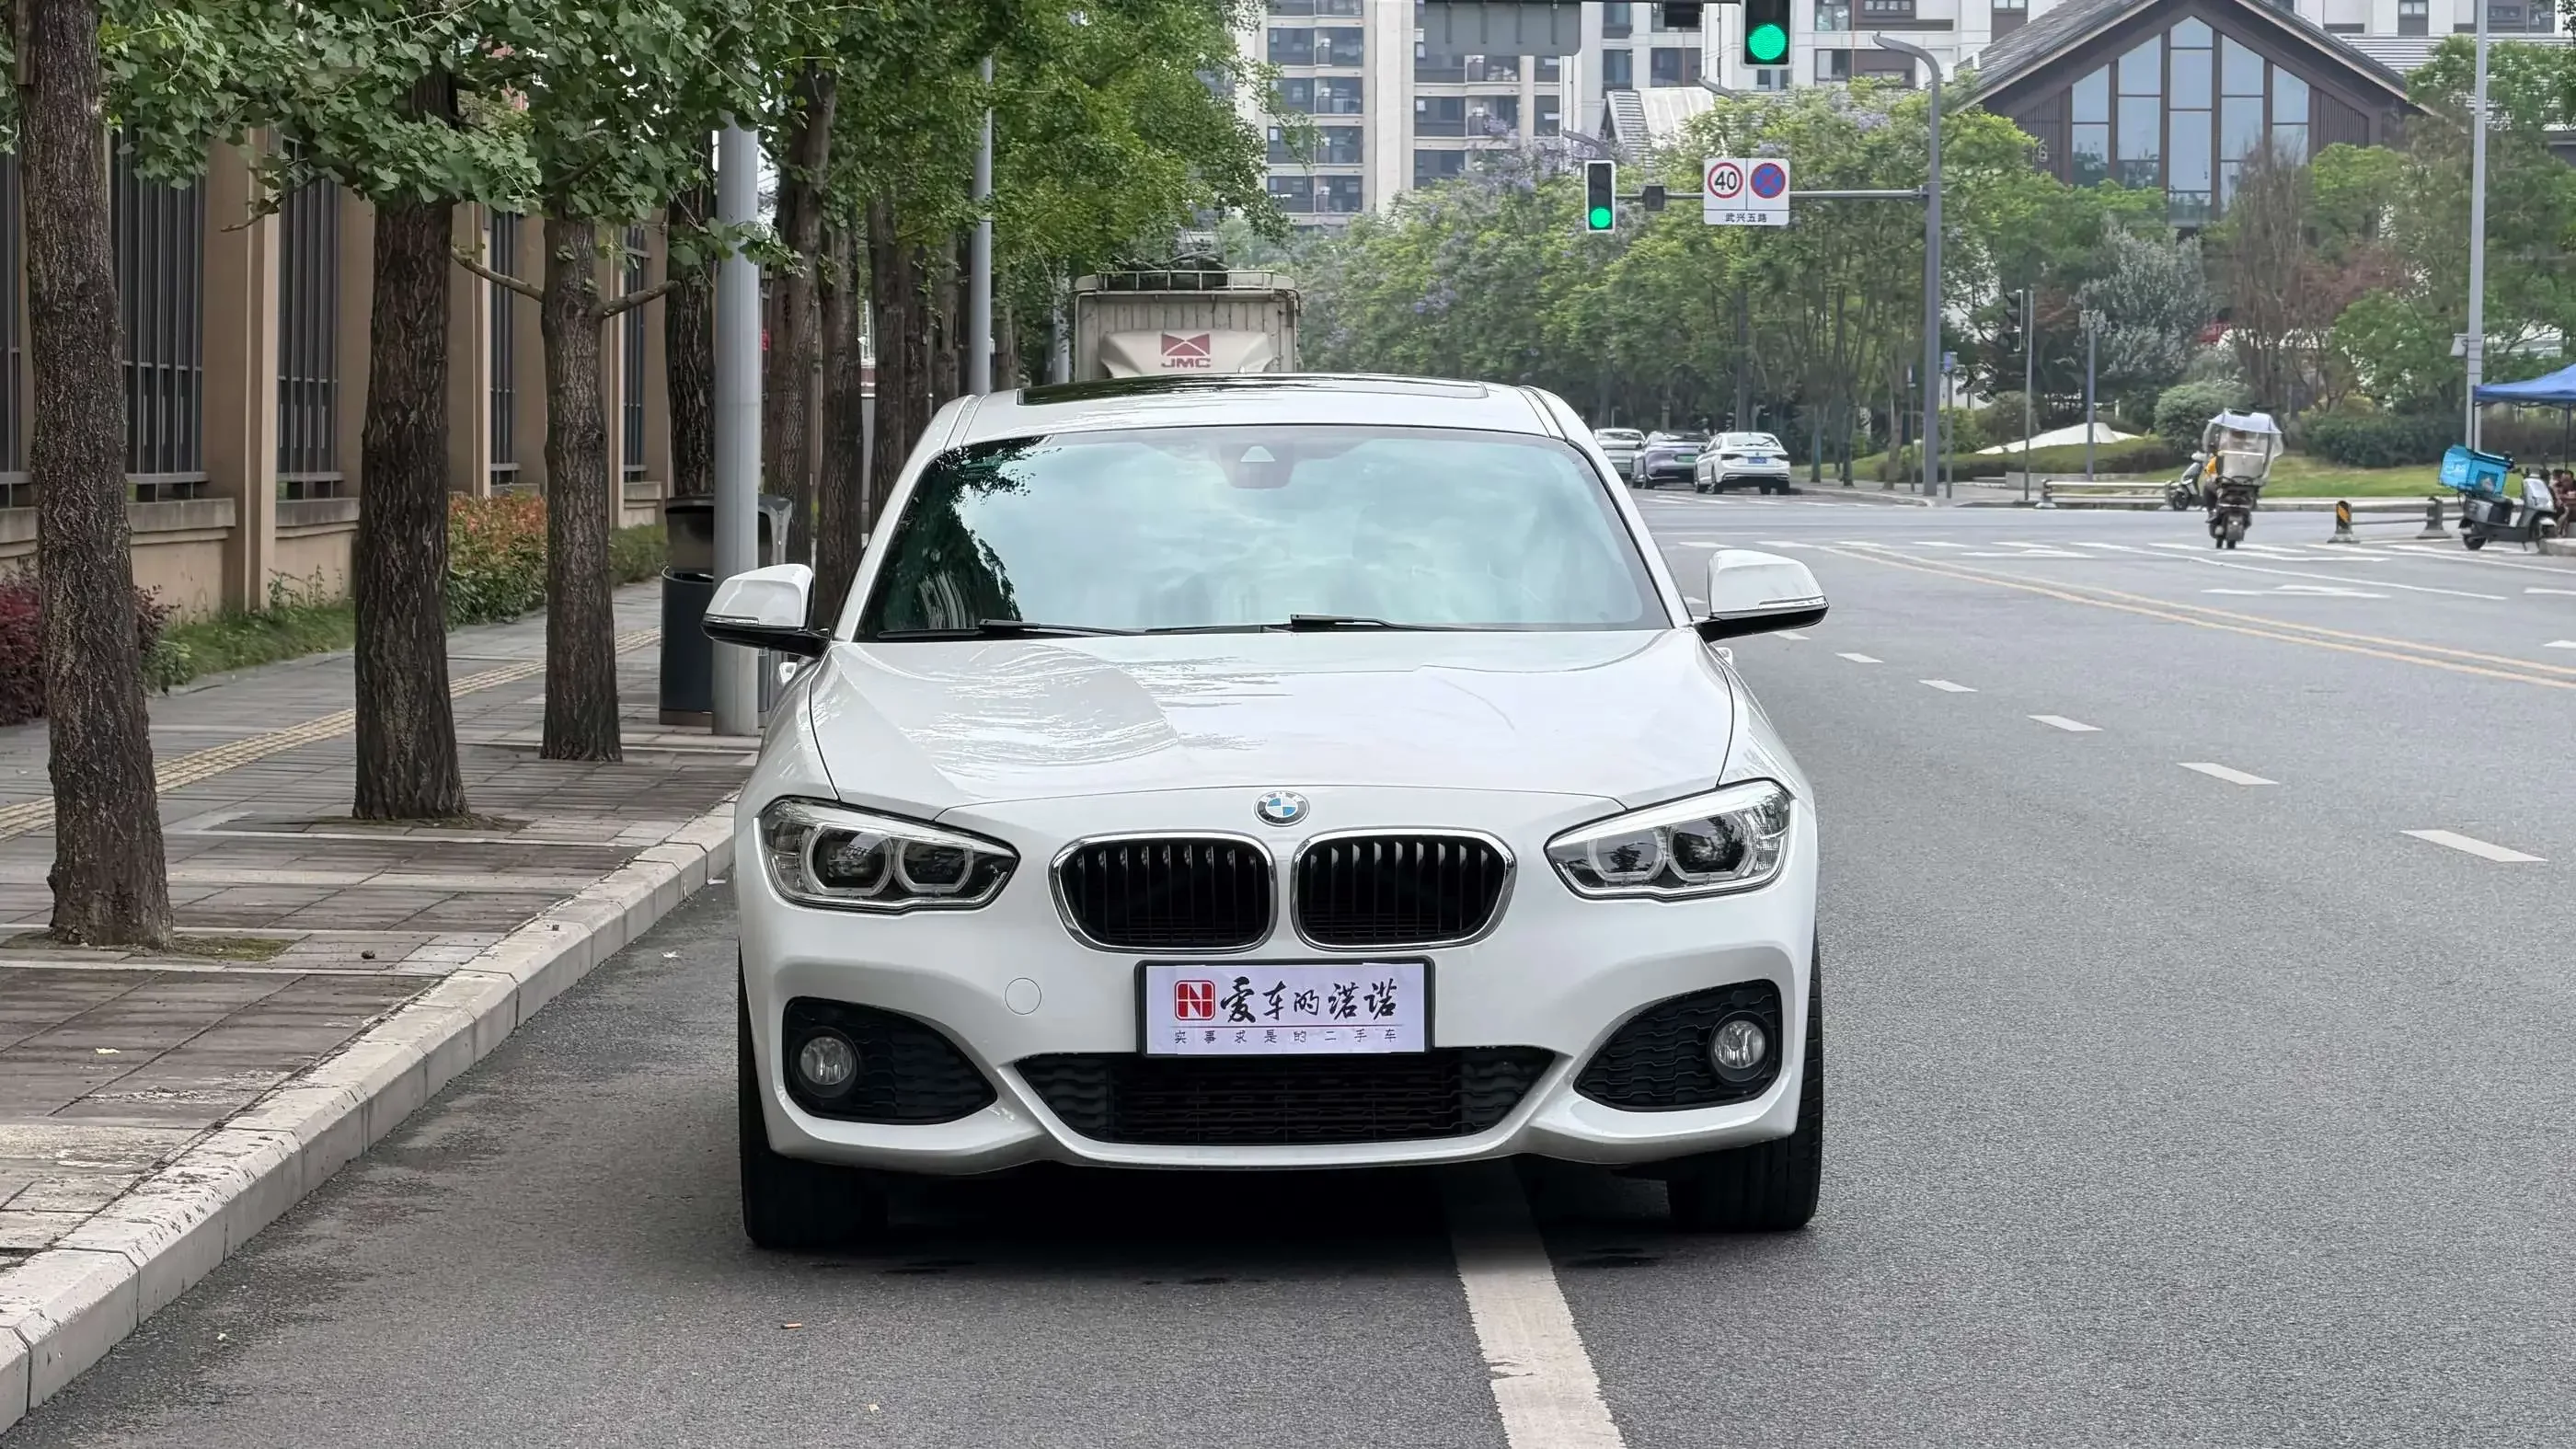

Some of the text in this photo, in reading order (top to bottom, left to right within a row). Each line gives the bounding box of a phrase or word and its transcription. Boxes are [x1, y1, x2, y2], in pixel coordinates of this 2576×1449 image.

[1714, 171, 1738, 190] 40
[1725, 213, 1767, 223] 武兴五路
[1161, 357, 1211, 368] JMC
[1174, 1029, 1397, 1044] 实事求是的二手车
